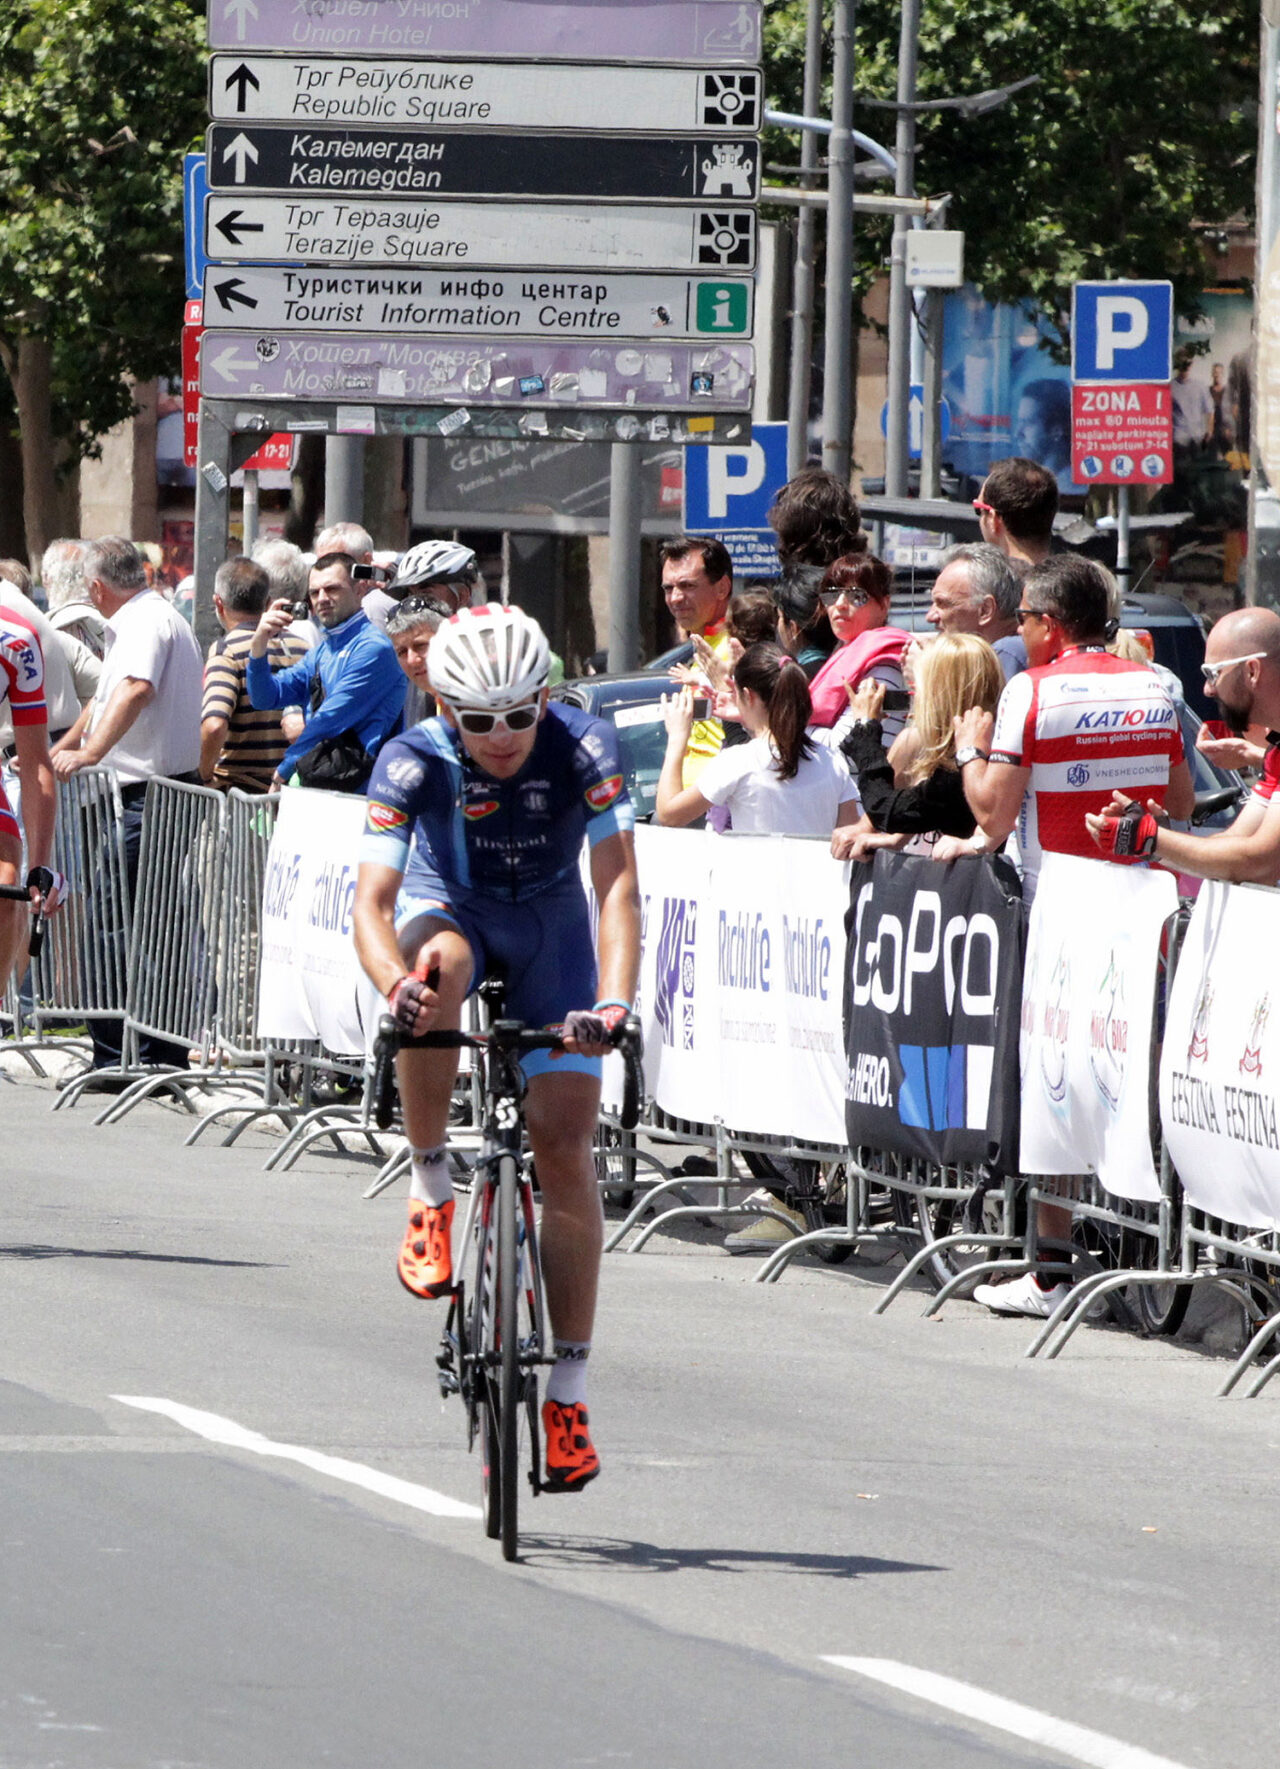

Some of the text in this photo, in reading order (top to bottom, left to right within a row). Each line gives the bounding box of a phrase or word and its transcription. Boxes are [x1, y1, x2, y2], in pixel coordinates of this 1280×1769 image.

[292, 22, 432, 45] Union Hotel
[293, 65, 332, 91] Трг
[292, 93, 491, 122] Republic Square
[290, 134, 445, 163] Калемегдан
[289, 162, 441, 191] Kalemegdan
[284, 205, 325, 229] Трг
[284, 232, 469, 260] Terazije Square
[283, 273, 608, 304] Туристички инфо центар
[283, 301, 621, 328] Tourist Information Centre
[1096, 296, 1148, 369] P
[1081, 391, 1141, 412] ZONA
[1075, 417, 1100, 427] max
[1127, 415, 1169, 427] minuta
[708, 438, 766, 517] P
[1076, 734, 1107, 744] Russian
[1109, 732, 1131, 744] global
[1132, 730, 1157, 741] cycling
[852, 882, 1000, 1018] GoPro
[1172, 1071, 1280, 1151] FESTINA FESTINA
